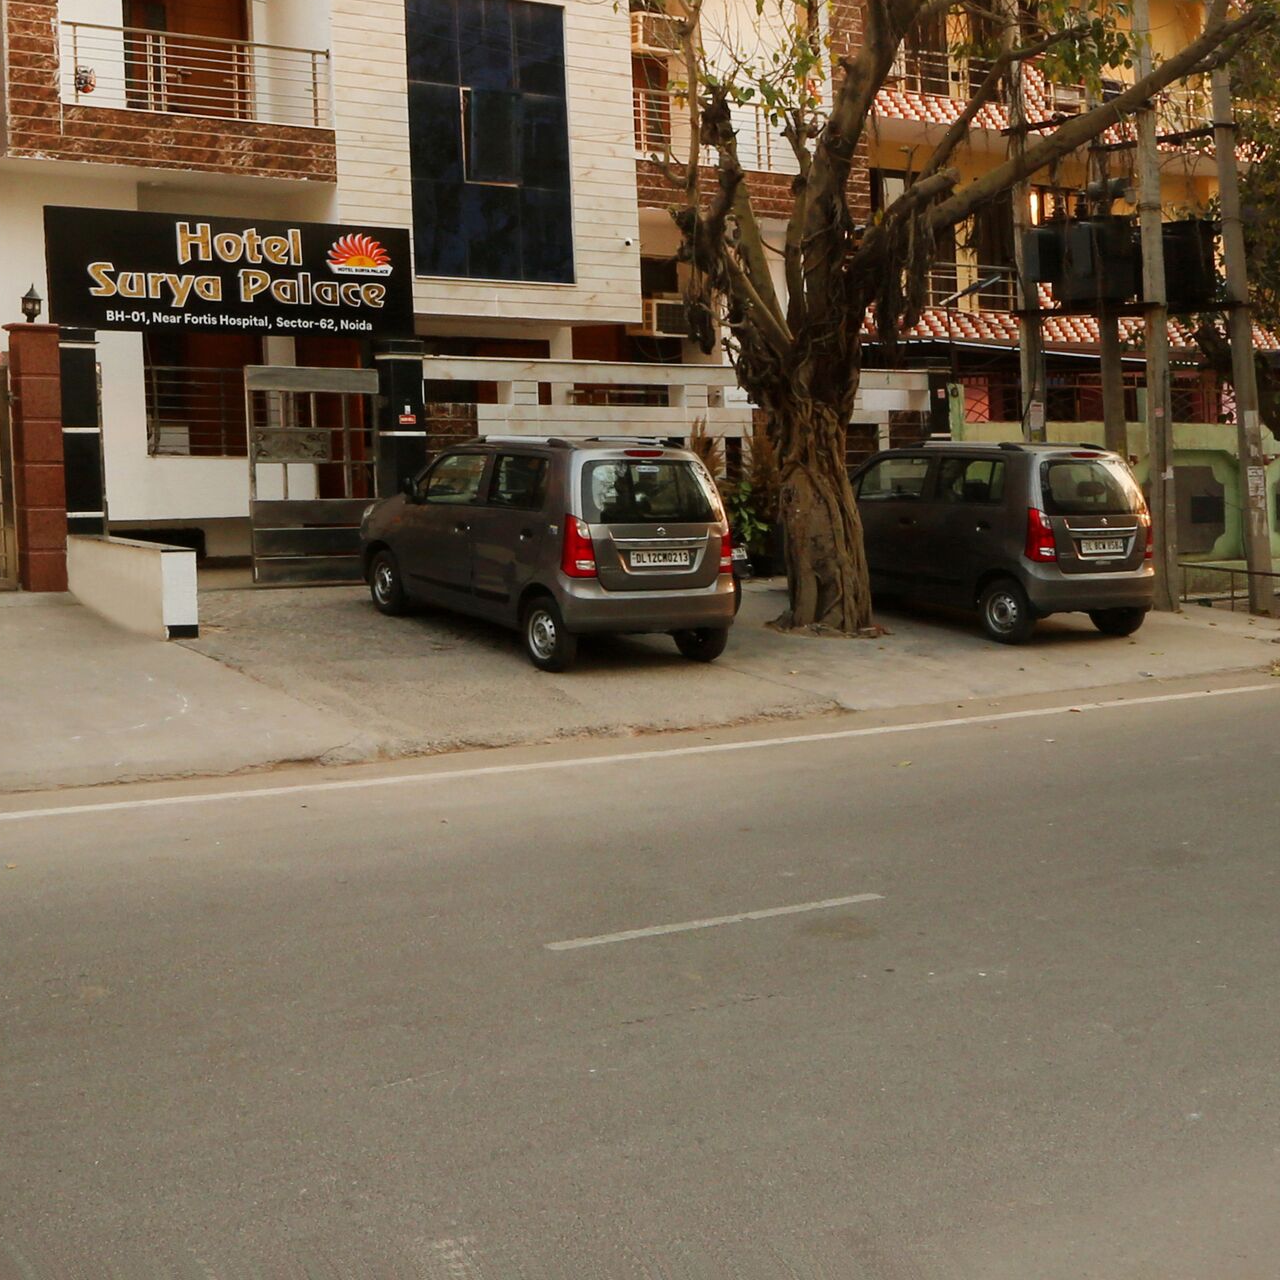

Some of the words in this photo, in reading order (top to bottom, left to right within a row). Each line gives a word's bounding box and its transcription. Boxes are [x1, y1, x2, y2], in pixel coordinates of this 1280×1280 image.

[175, 221, 303, 267] Hotel
[86, 261, 223, 308] Surya
[238, 268, 387, 309] Palace
[106, 310, 150, 325] BH-01,
[152, 312, 182, 324] Near
[184, 313, 218, 326] Fortis
[219, 314, 272, 330] Hospital,
[276, 316, 339, 332] Sector-62,
[340, 319, 373, 331] Noida
